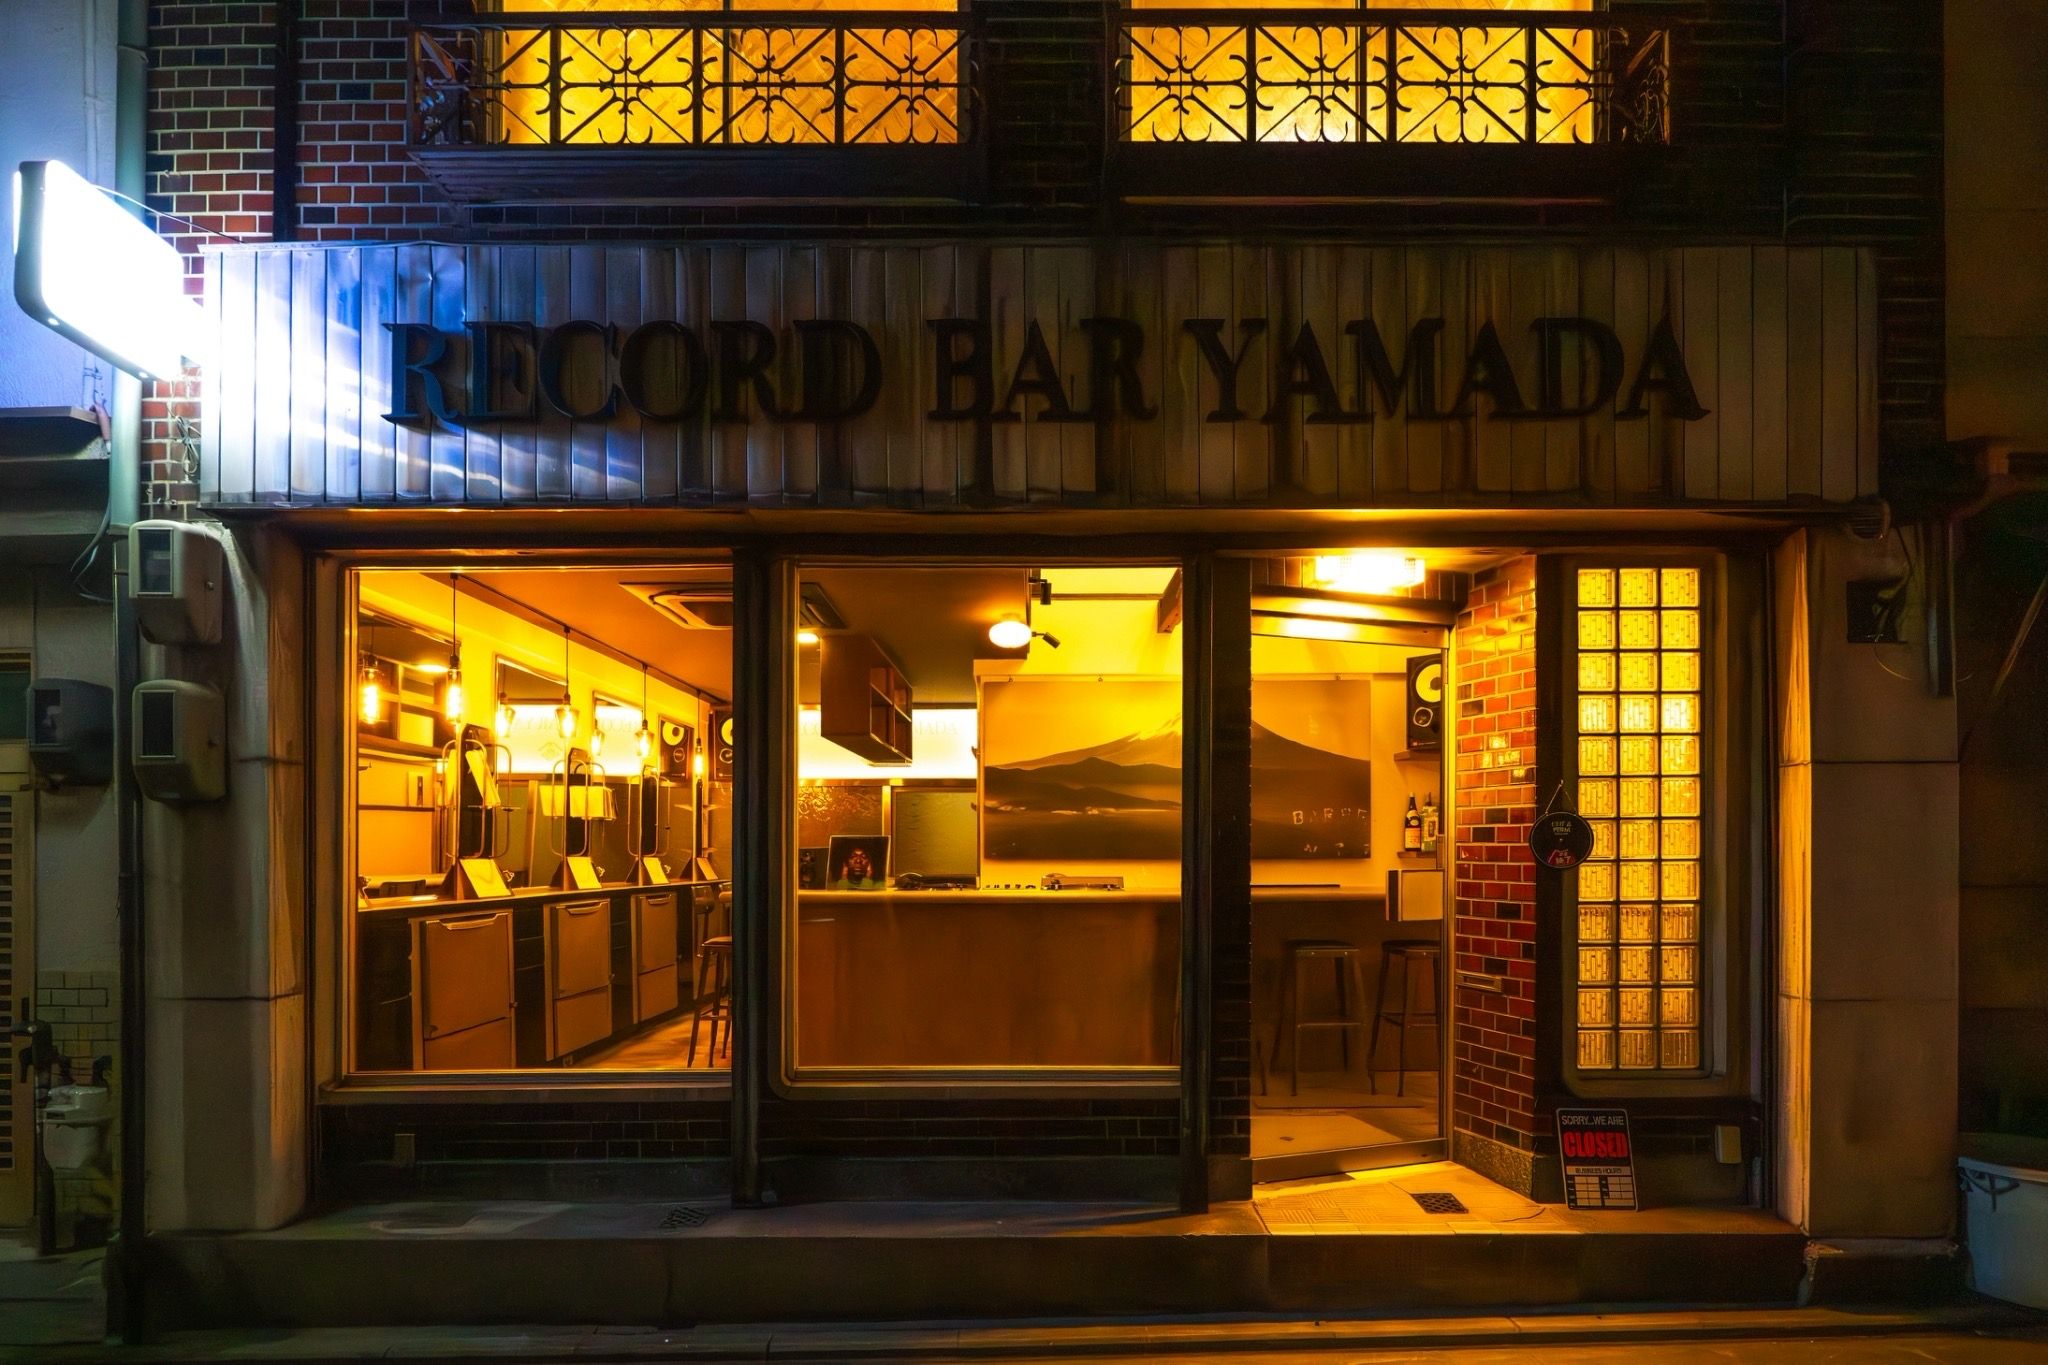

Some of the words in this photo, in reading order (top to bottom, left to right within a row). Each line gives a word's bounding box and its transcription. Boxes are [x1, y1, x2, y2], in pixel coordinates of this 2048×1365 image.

[381, 319, 884, 424] RECORD
[926, 318, 1158, 421] BAR
[1183, 317, 1711, 424] YAMADA
[1607, 1115, 1625, 1126] ARE
[1563, 1131, 1629, 1158] CLOSED
